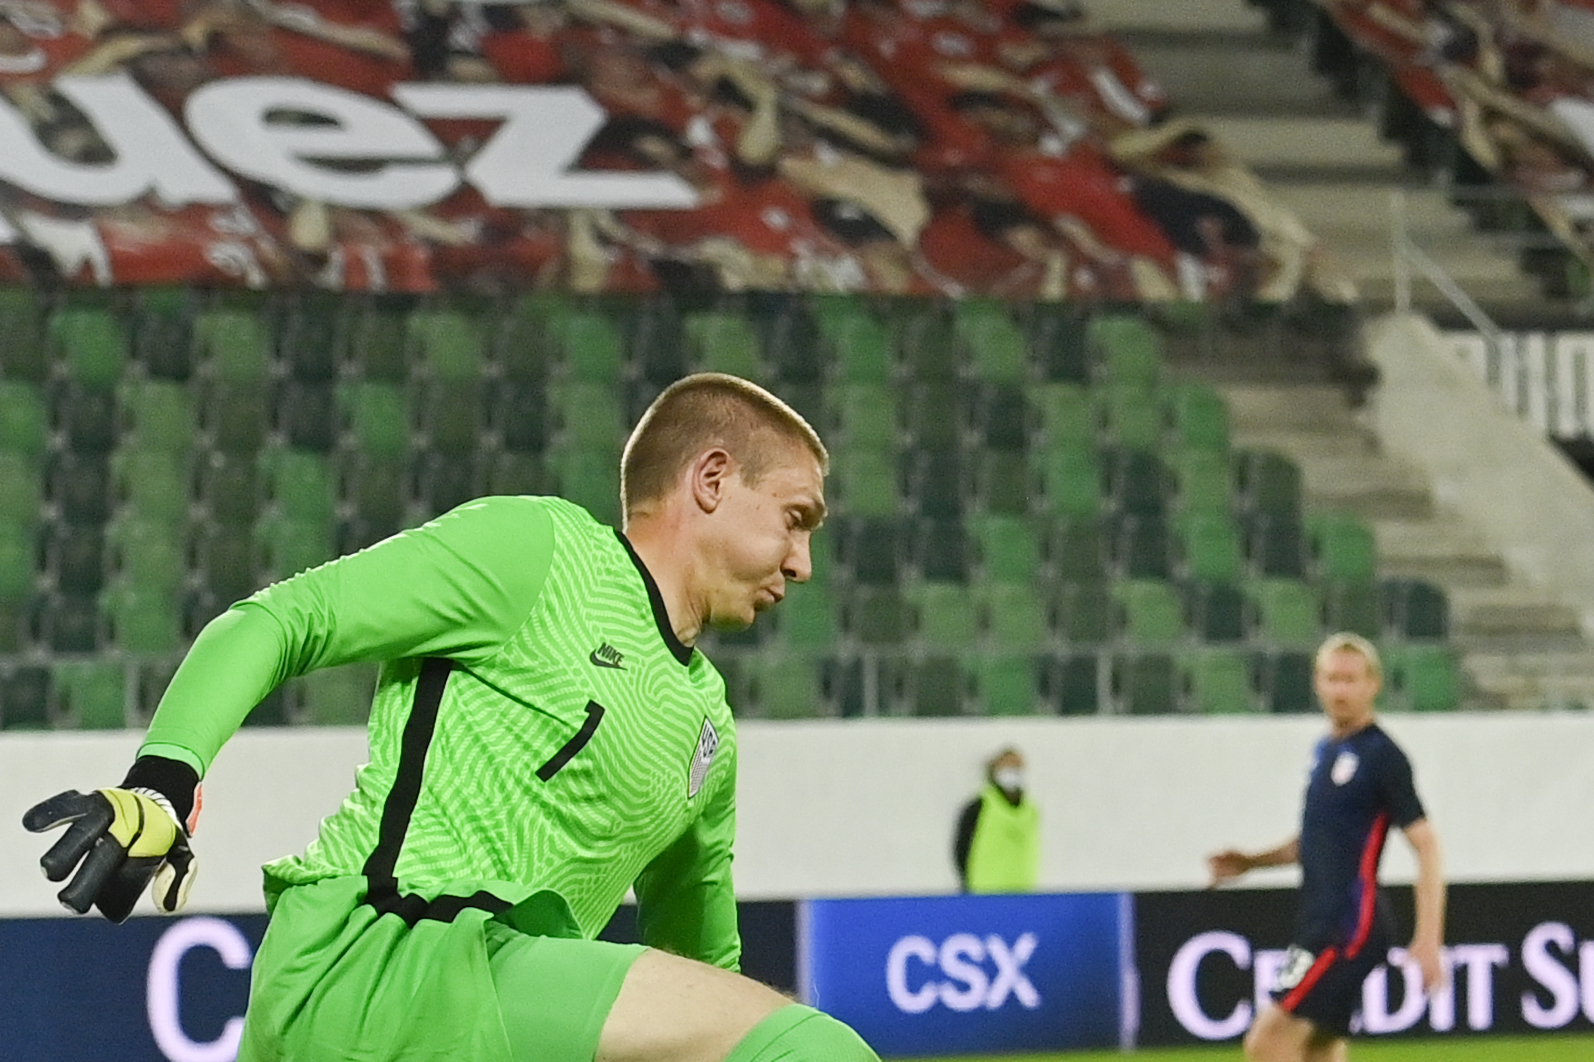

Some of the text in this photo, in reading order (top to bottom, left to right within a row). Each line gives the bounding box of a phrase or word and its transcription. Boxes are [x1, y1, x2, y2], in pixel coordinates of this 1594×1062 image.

[597, 641, 625, 666] NIKE
[535, 699, 606, 783] 1
[885, 931, 1041, 1014] CSX
[1166, 930, 1509, 1040] CDIT
